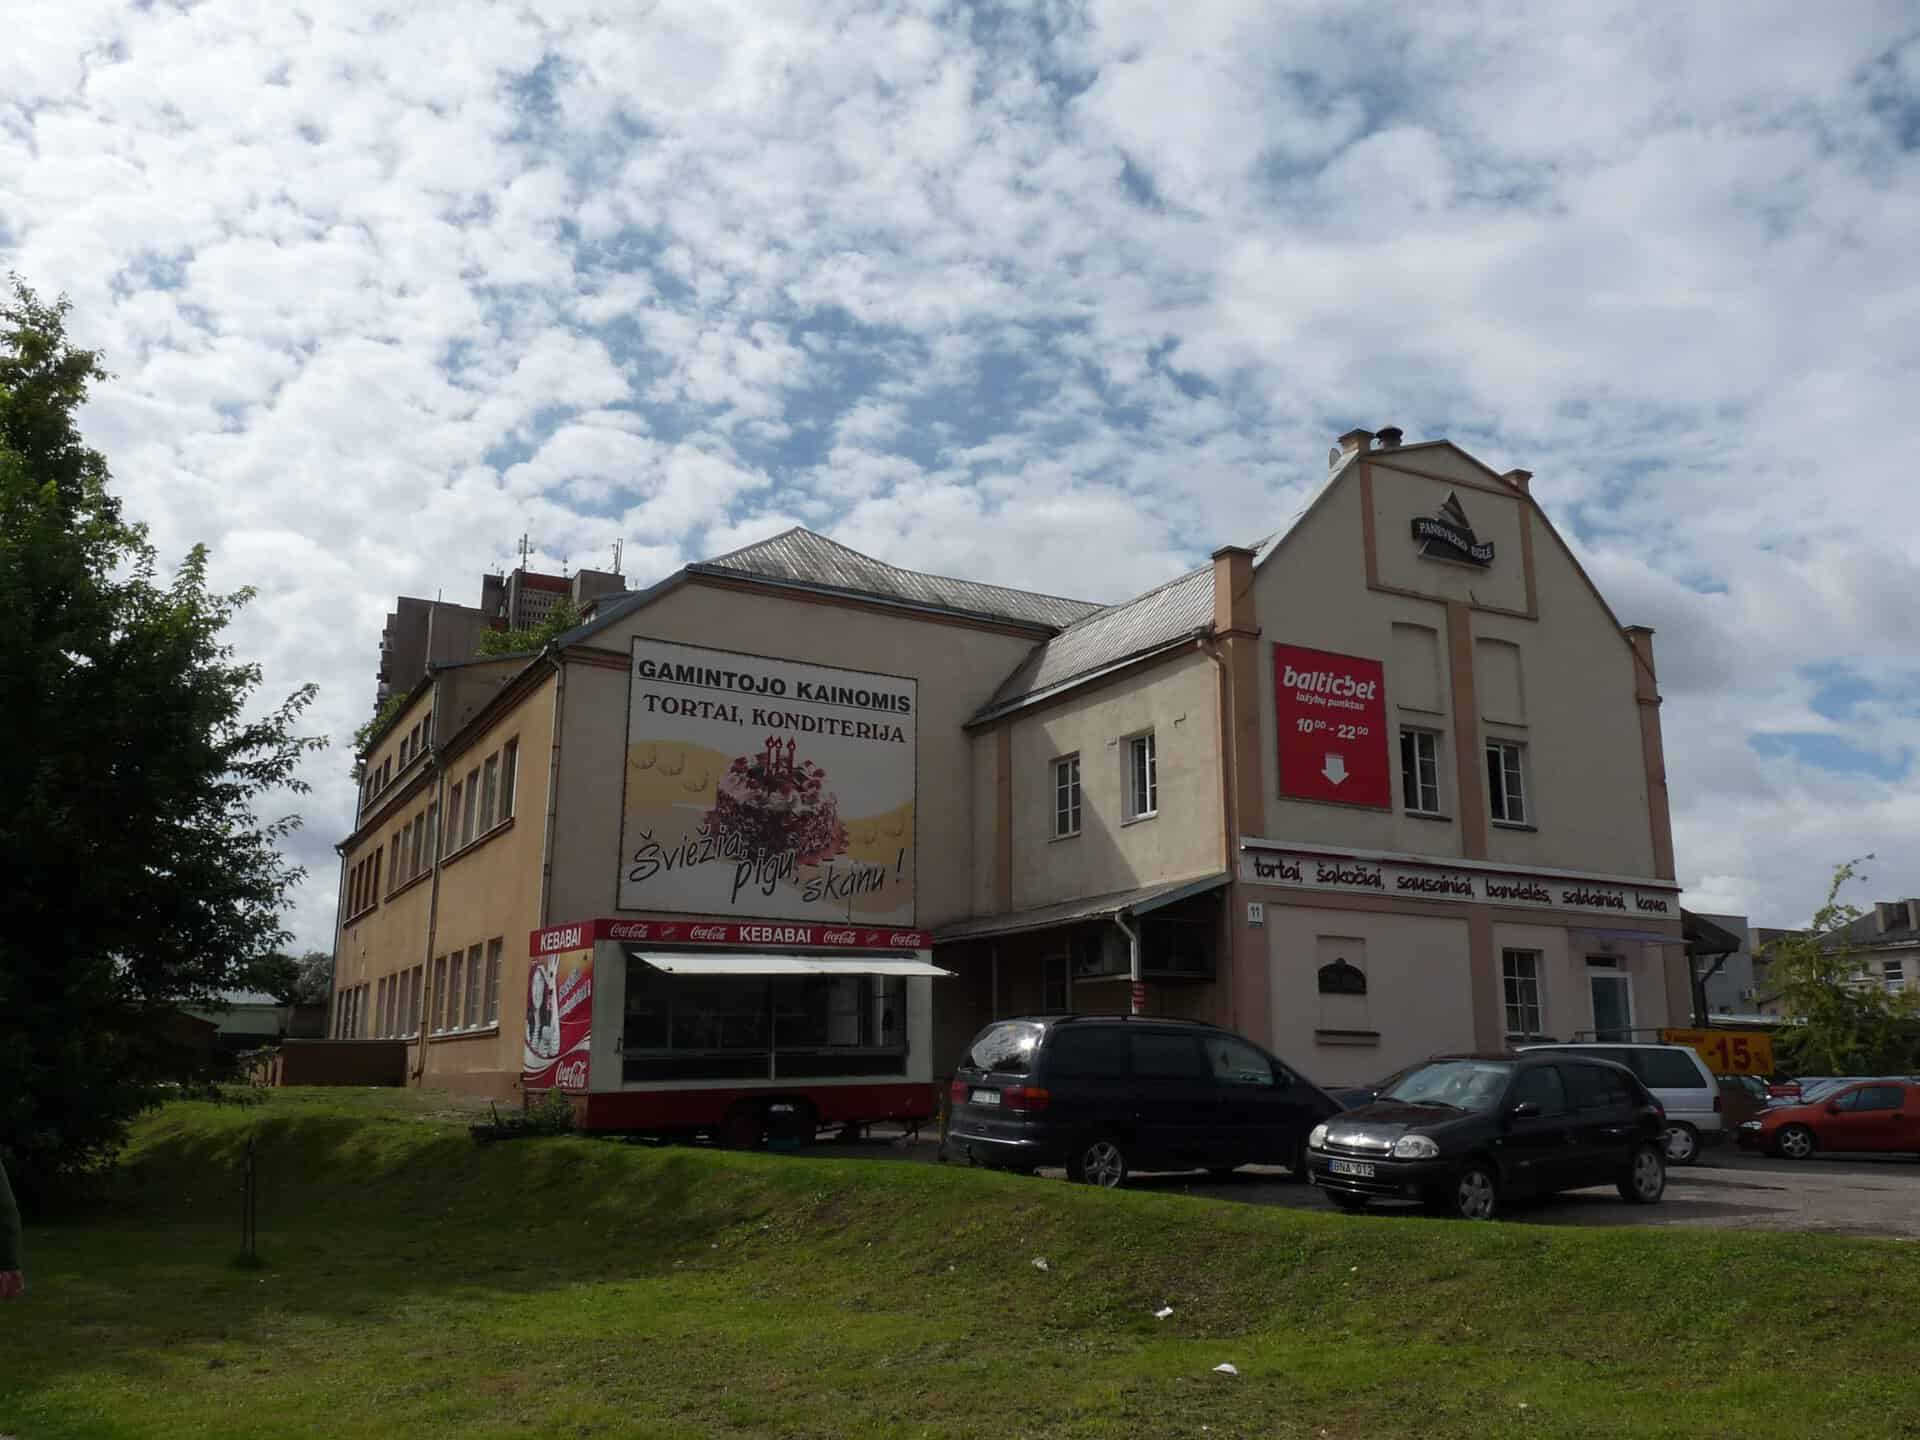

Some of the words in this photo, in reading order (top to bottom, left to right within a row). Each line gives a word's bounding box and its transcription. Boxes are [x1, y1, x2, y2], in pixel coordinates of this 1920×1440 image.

[638, 659, 787, 696] GAMINTOJO
[797, 681, 911, 713] KAINOMIS
[1282, 665, 1377, 700] balticbet
[643, 694, 744, 726] TORTAI,
[751, 707, 906, 744] KONDITERIJA
[629, 824, 748, 882] Šviežia,
[731, 846, 799, 904] pigu,
[802, 863, 886, 902] skanu
[1254, 857, 1303, 882] tortai,
[1316, 862, 1385, 889] šakočiai,
[1397, 874, 1474, 897] sausainiai,
[1486, 879, 1552, 904] bandelės,
[1562, 887, 1626, 911] saldainiai,
[1636, 892, 1668, 913] kava
[540, 927, 582, 952] KEBABAI
[739, 926, 812, 944] KEBABAI
